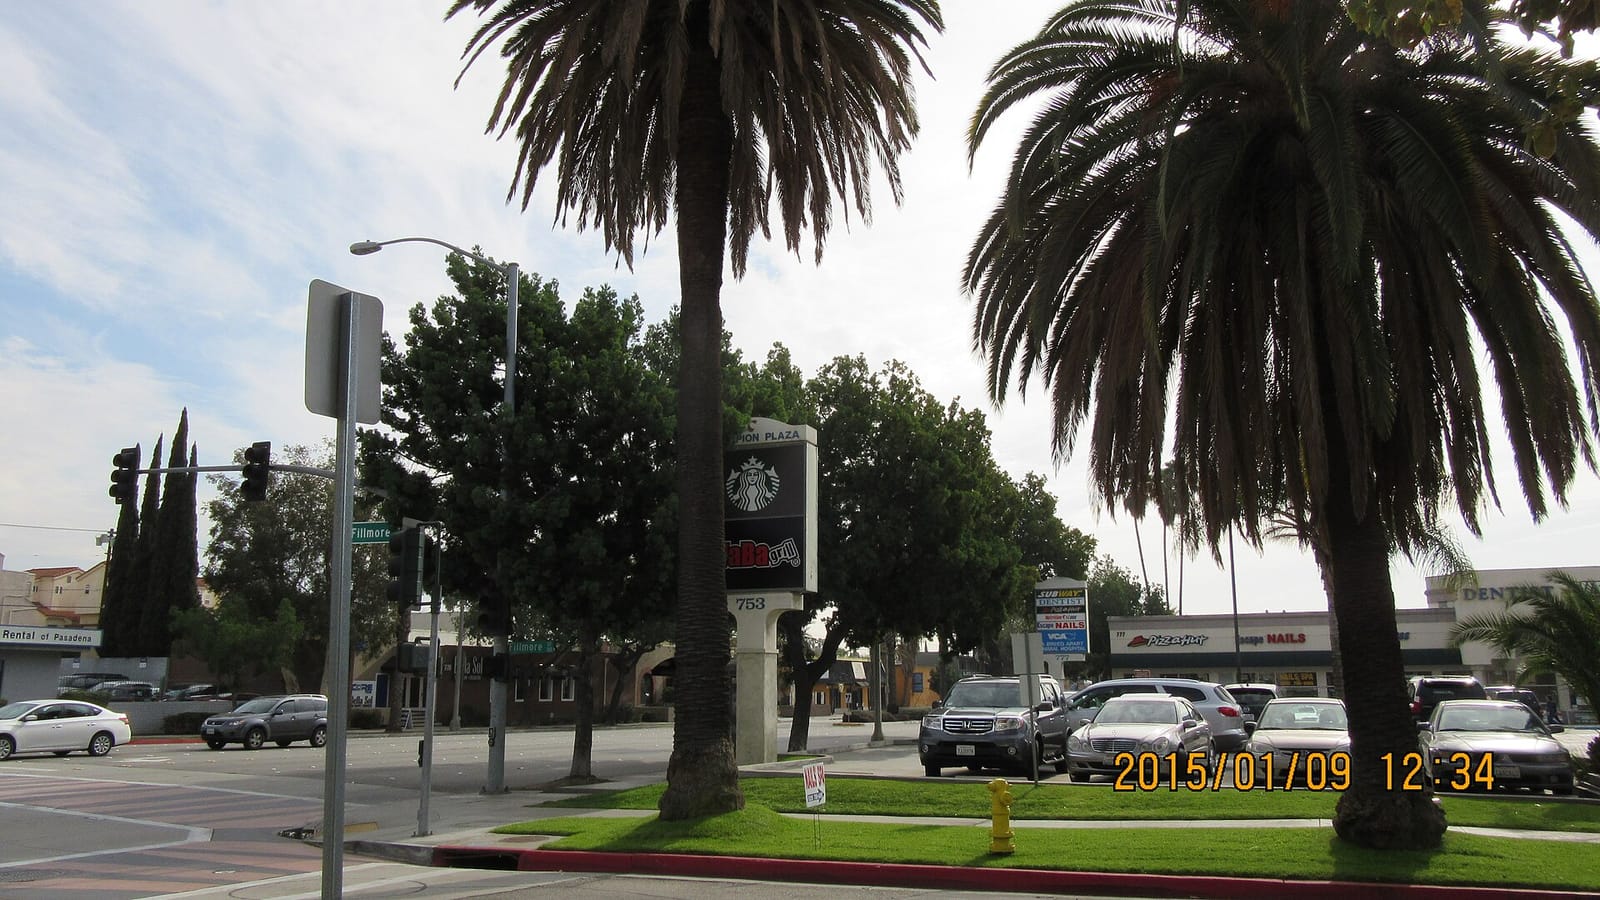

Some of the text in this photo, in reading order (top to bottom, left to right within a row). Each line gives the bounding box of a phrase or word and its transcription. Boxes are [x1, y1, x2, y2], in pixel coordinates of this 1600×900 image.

[736, 430, 800, 443] PION PLAZA
[352, 527, 391, 539] Fillmore
[724, 540, 797, 569] aBa grill
[736, 597, 766, 610] 753
[1039, 598, 1083, 606] DENTIST
[2, 629, 92, 643] Rental of Pasadena
[1239, 633, 1307, 646] scape NAILS
[509, 641, 543, 652] Fillmore
